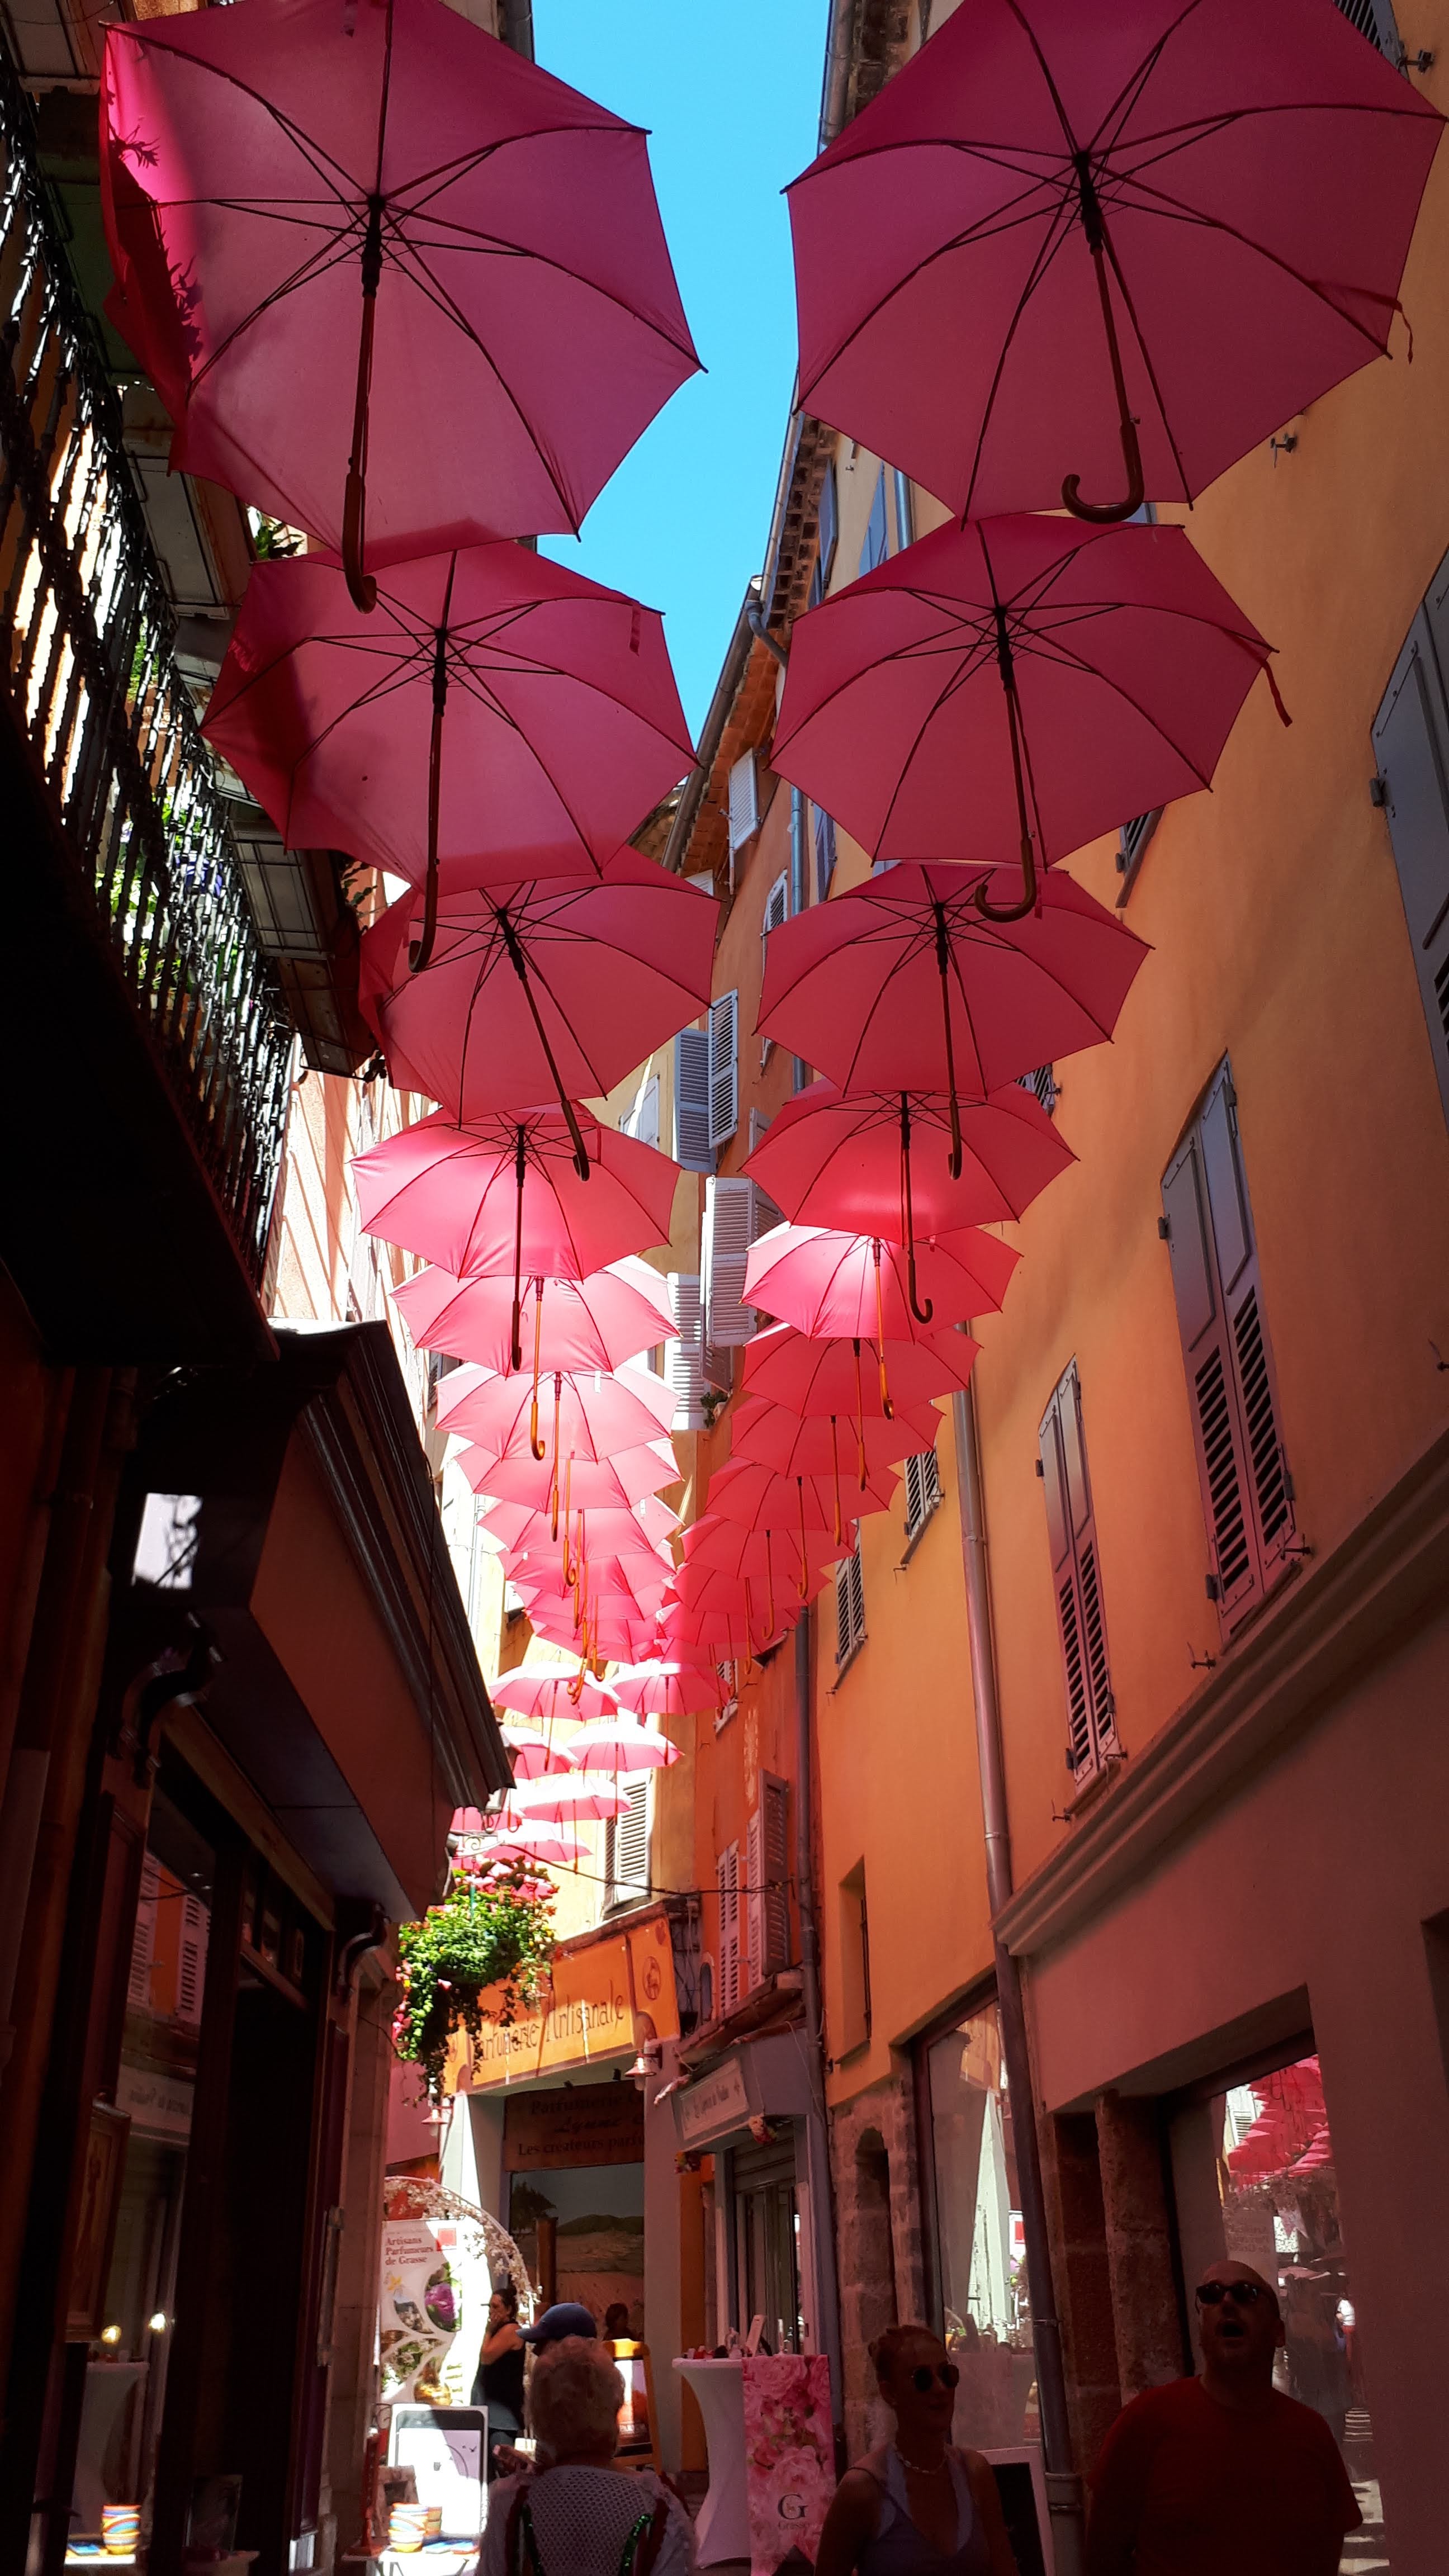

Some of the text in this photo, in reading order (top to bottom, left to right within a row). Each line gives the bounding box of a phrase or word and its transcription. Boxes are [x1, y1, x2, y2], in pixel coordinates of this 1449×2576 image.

[473, 1979, 624, 2061] rfumerie Artisanale
[387, 2237, 422, 2245] Artisans
[386, 2246, 434, 2255] Parfumeurs
[385, 2257, 396, 2265] de
[778, 2494, 808, 2520] G
